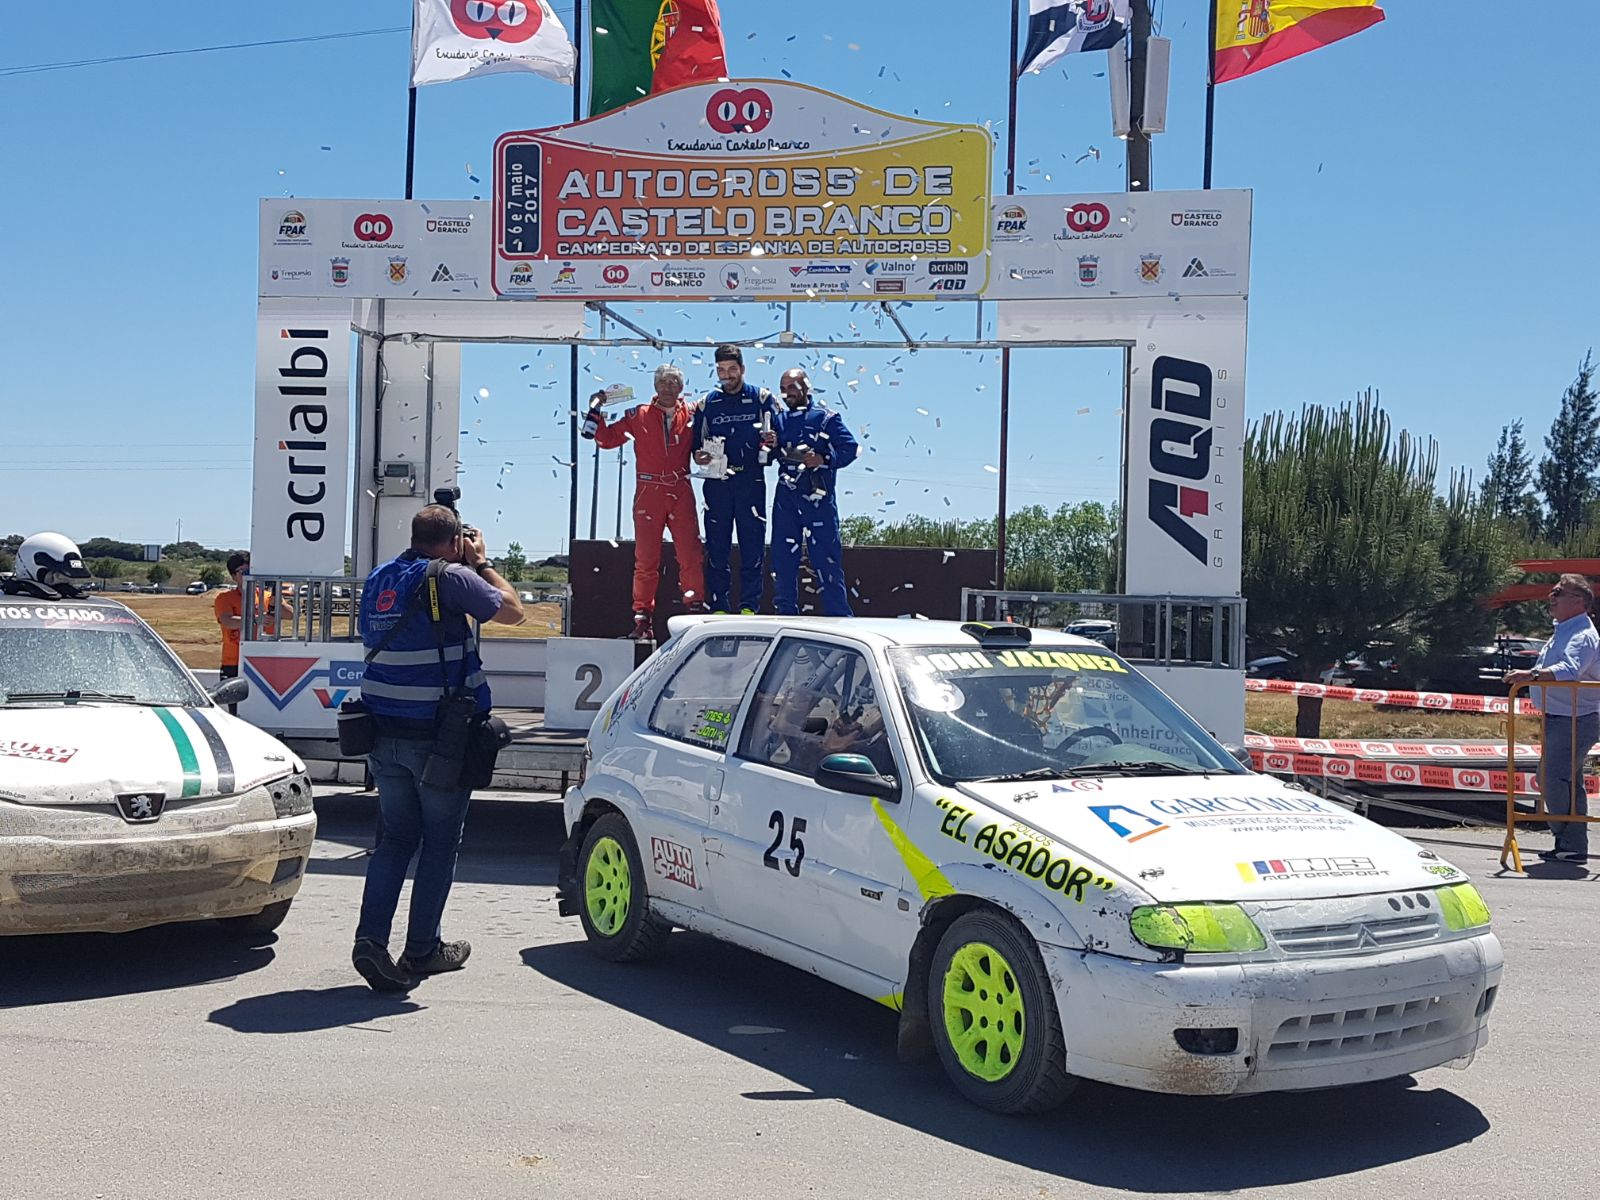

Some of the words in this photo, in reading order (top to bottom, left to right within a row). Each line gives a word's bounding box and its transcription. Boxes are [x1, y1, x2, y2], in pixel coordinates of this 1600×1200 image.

[667, 138, 722, 151] Escuderia
[507, 163, 523, 196] maio
[556, 167, 856, 199] AUTOCROSS
[883, 166, 953, 196] DE
[507, 201, 523, 210] 7
[524, 174, 538, 224] 2017
[511, 213, 523, 221] e
[556, 206, 756, 237] CASTELO
[764, 204, 952, 236] BRANCO
[279, 225, 307, 235] FPAK
[507, 225, 523, 234] 6
[996, 220, 1027, 231] FPAK
[556, 241, 682, 256] CAMPEONATO
[685, 242, 711, 256] DE
[714, 241, 803, 255] ESPANHA
[806, 240, 836, 255] DE
[837, 239, 951, 255] AUTOCROSS
[881, 261, 916, 272] Valnor
[930, 263, 966, 273] acrialbi
[664, 279, 703, 287] BRANCO
[743, 276, 777, 286] Freguesia
[928, 278, 966, 291] AQD
[277, 328, 329, 542] acrialbi
[1148, 355, 1213, 567] AQD
[1213, 368, 1228, 568] GRAPHICS
[34, 606, 105, 622] CASADO
[913, 651, 994, 673] JONI
[995, 650, 1129, 674] VAZQUEZ
[574, 663, 604, 711] 2
[1455, 698, 1481, 706] PERIGO
[1296, 758, 1320, 766] PERIGO
[1358, 764, 1383, 772] PERIGO
[1358, 772, 1383, 780] DANGER
[1423, 769, 1449, 778] PERIGO
[1424, 778, 1450, 786] DANGER
[1150, 796, 1333, 815] GARCYMUR
[763, 810, 808, 878] 25
[654, 838, 693, 869] AUTO
[1283, 856, 1376, 873] NS
[654, 858, 694, 885] SPORT
[1262, 869, 1391, 882] MOTORSPORT
